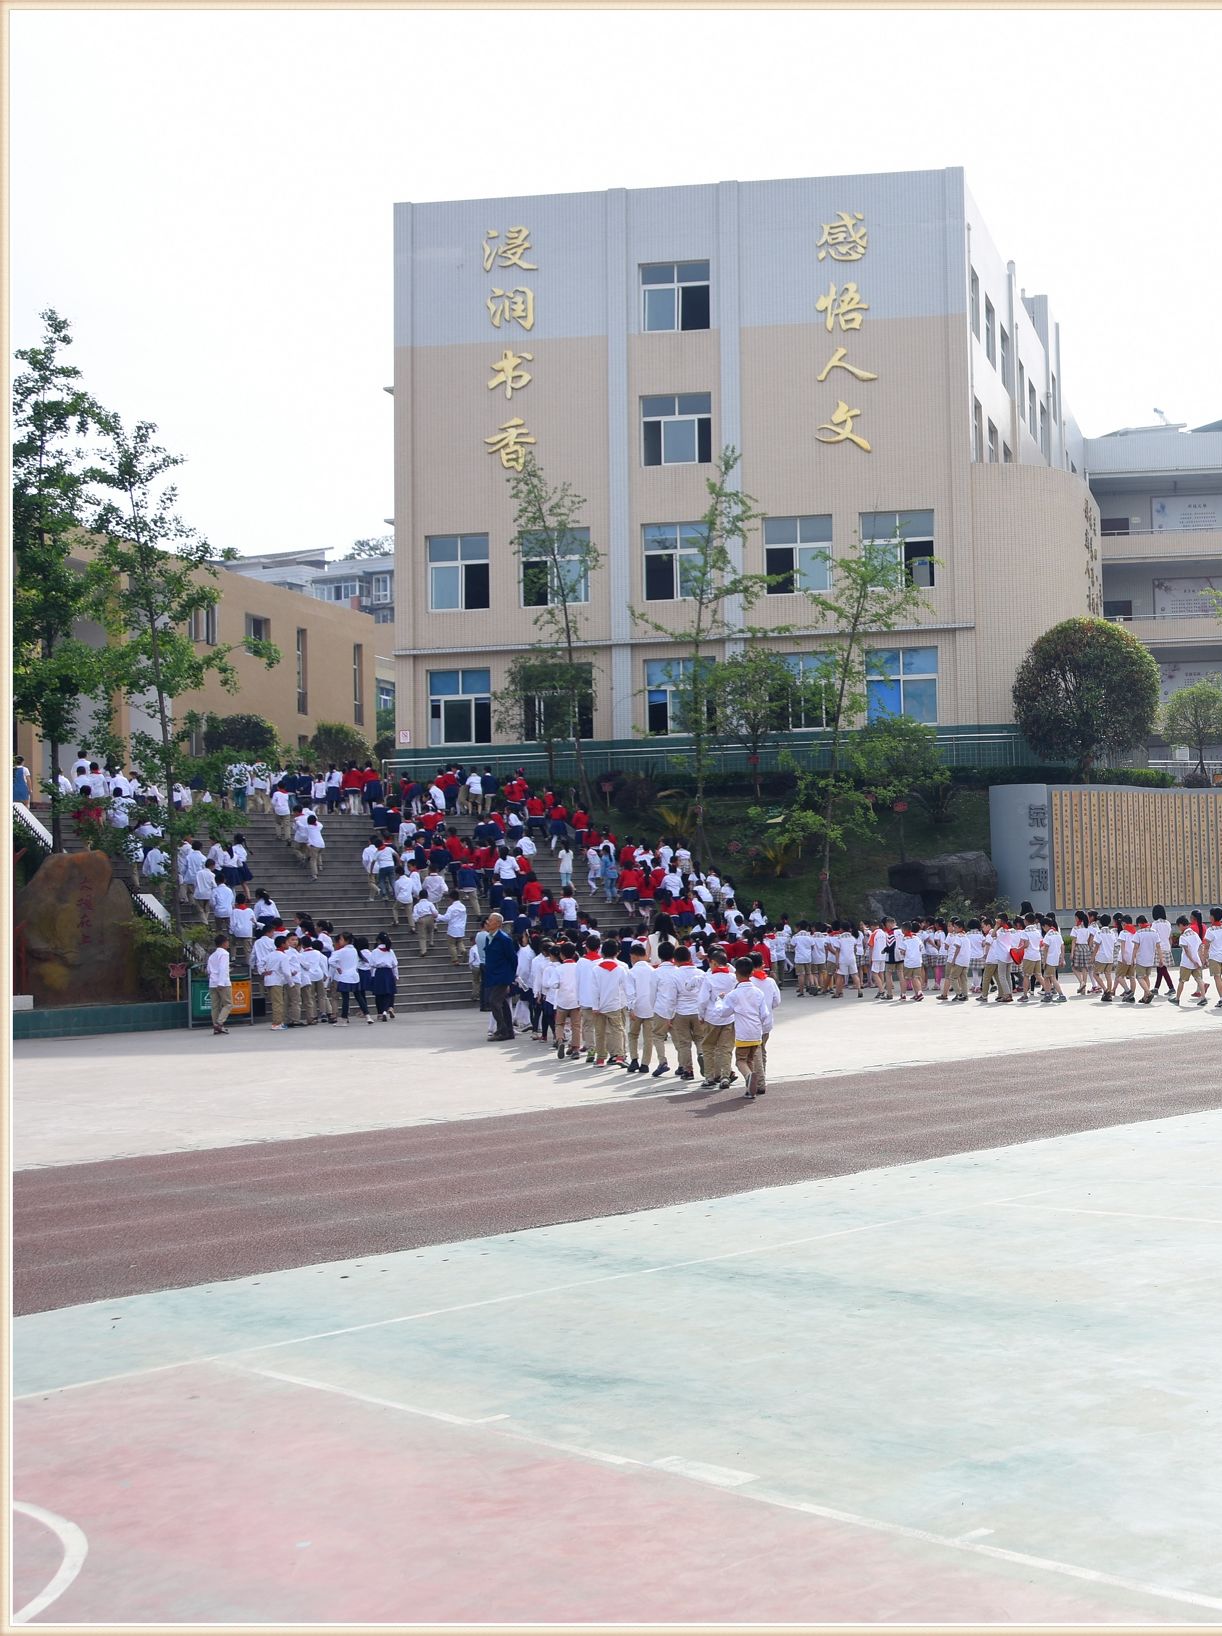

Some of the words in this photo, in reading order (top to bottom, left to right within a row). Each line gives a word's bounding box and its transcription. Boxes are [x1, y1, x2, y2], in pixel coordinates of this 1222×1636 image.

[482, 226, 538, 473] 浸润书香
[815, 212, 878, 453] 感悟人文
